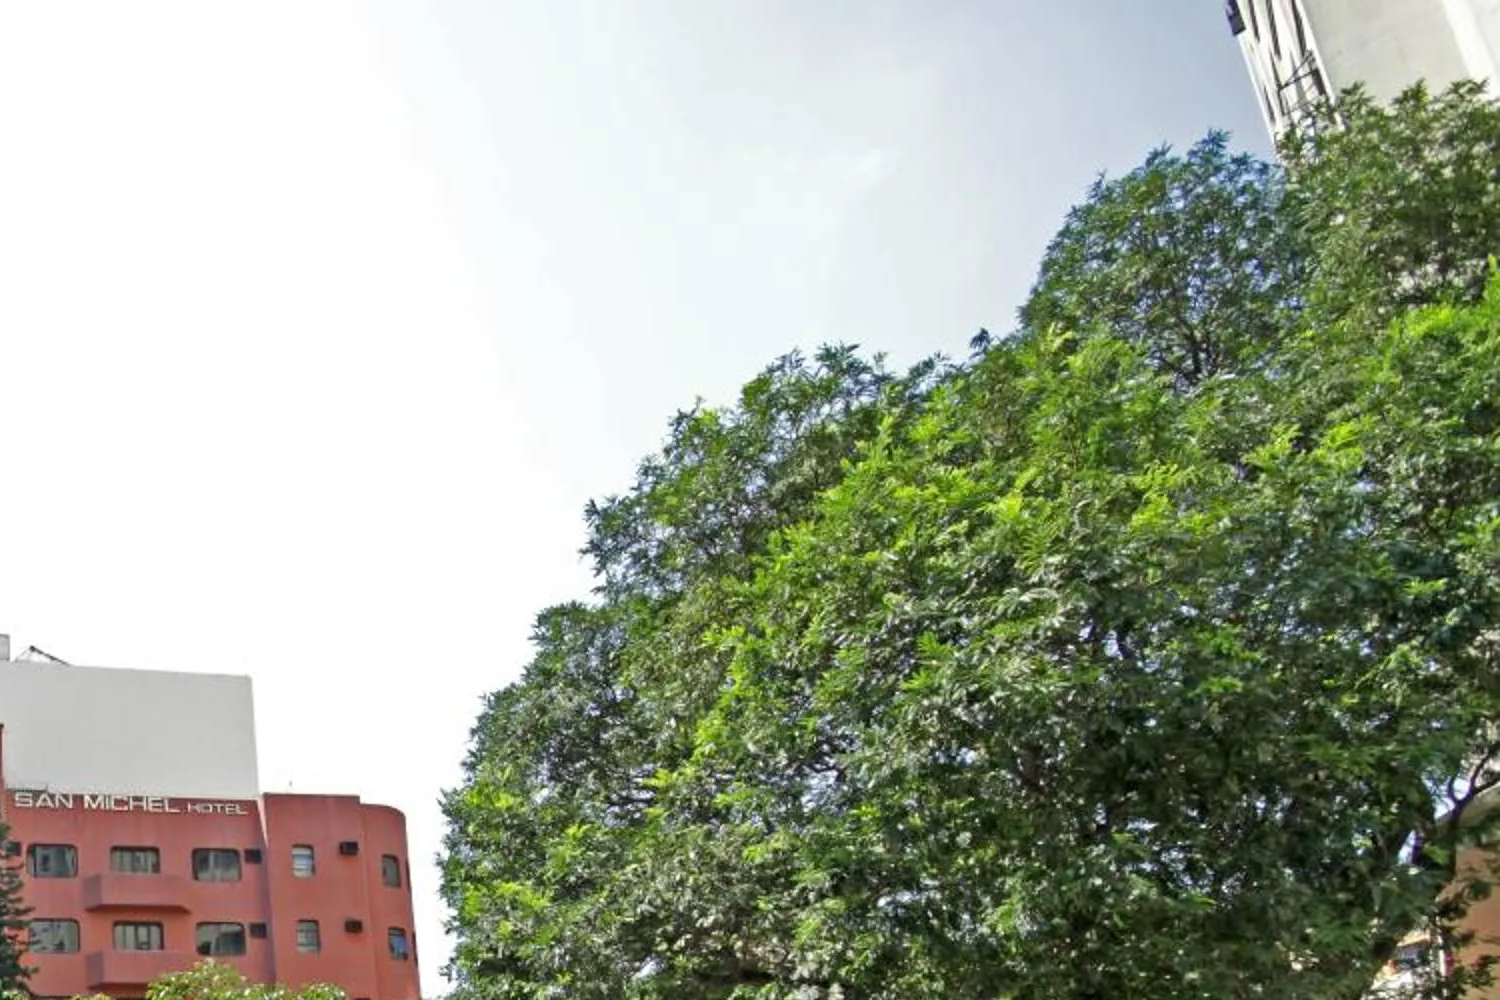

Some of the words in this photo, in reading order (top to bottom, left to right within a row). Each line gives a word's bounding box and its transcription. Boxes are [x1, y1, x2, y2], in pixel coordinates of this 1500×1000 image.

[14, 791, 73, 809] SAN
[83, 794, 181, 813] MICHEL
[187, 803, 249, 815] HOTEL
